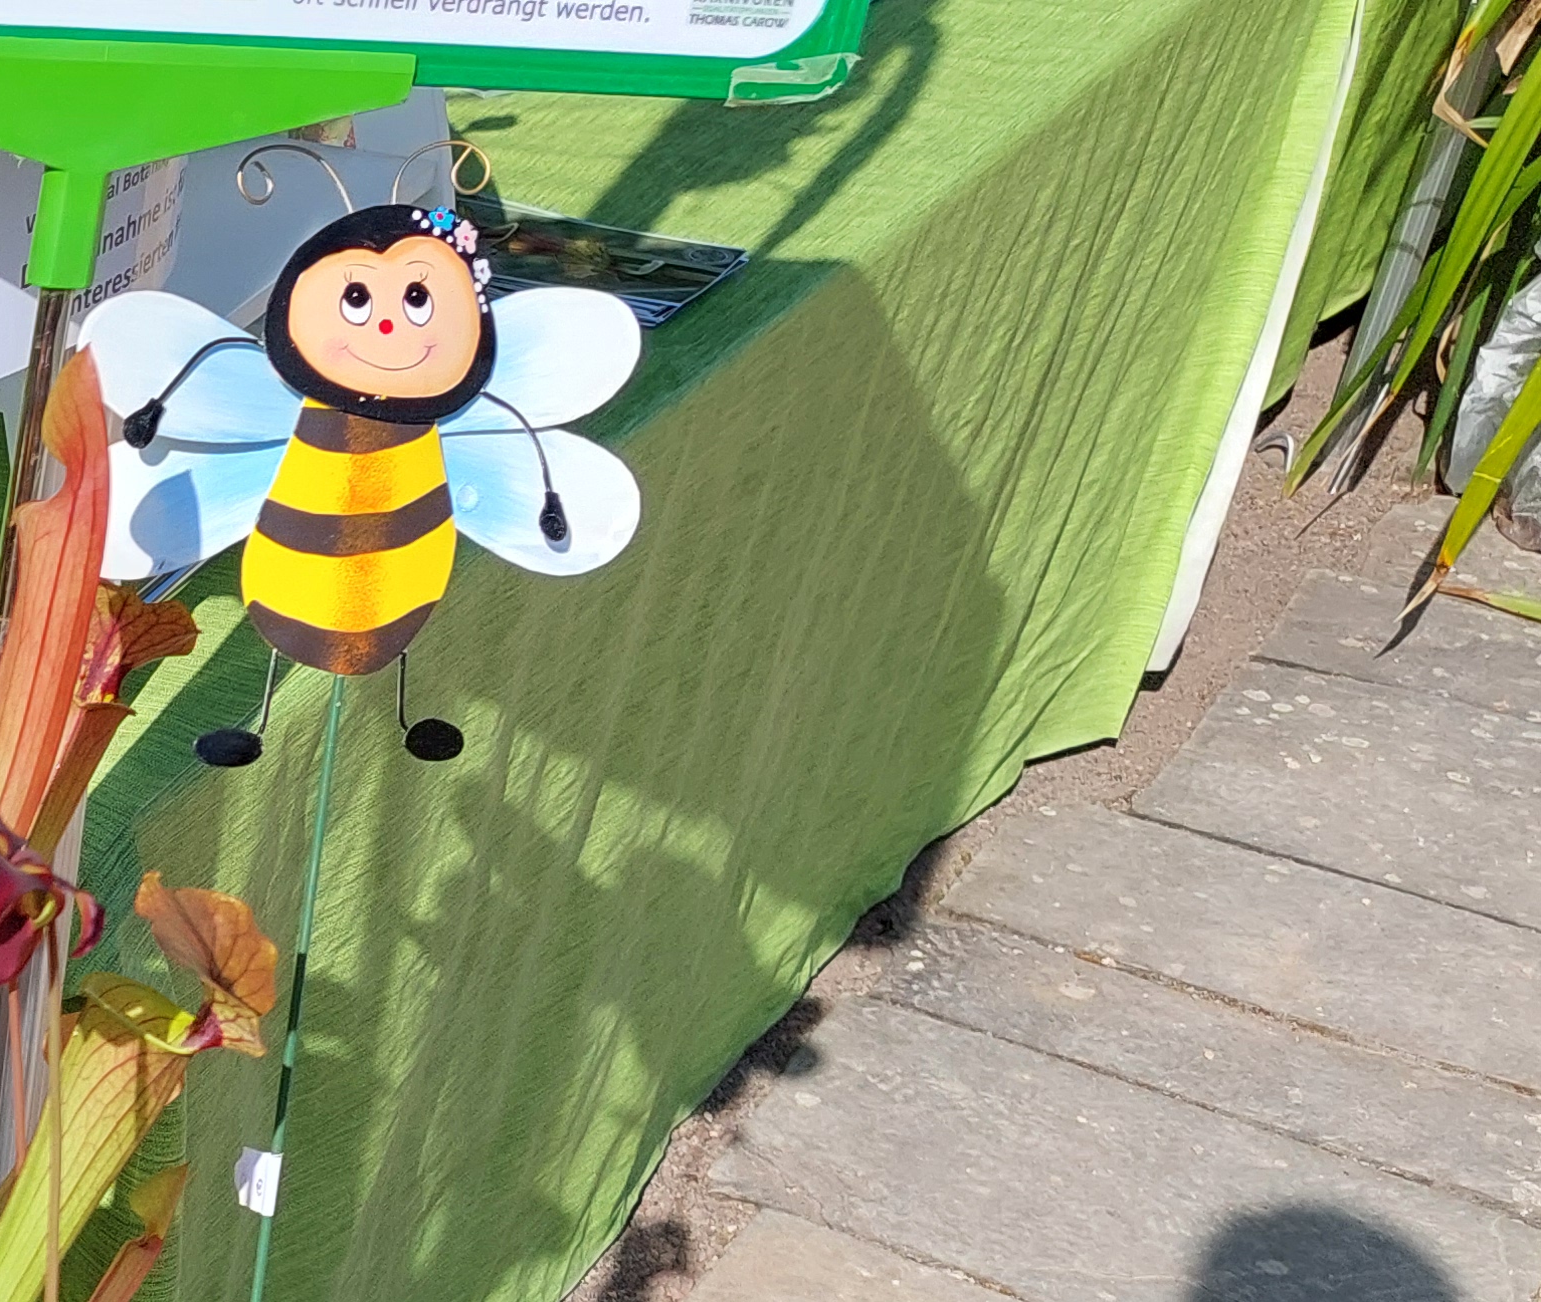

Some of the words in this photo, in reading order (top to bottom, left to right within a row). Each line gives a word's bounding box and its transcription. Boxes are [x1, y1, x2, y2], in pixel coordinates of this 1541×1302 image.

[557, 0, 650, 23] werden.
[689, 13, 739, 26] THOMAS
[741, 16, 789, 28] CAROW
